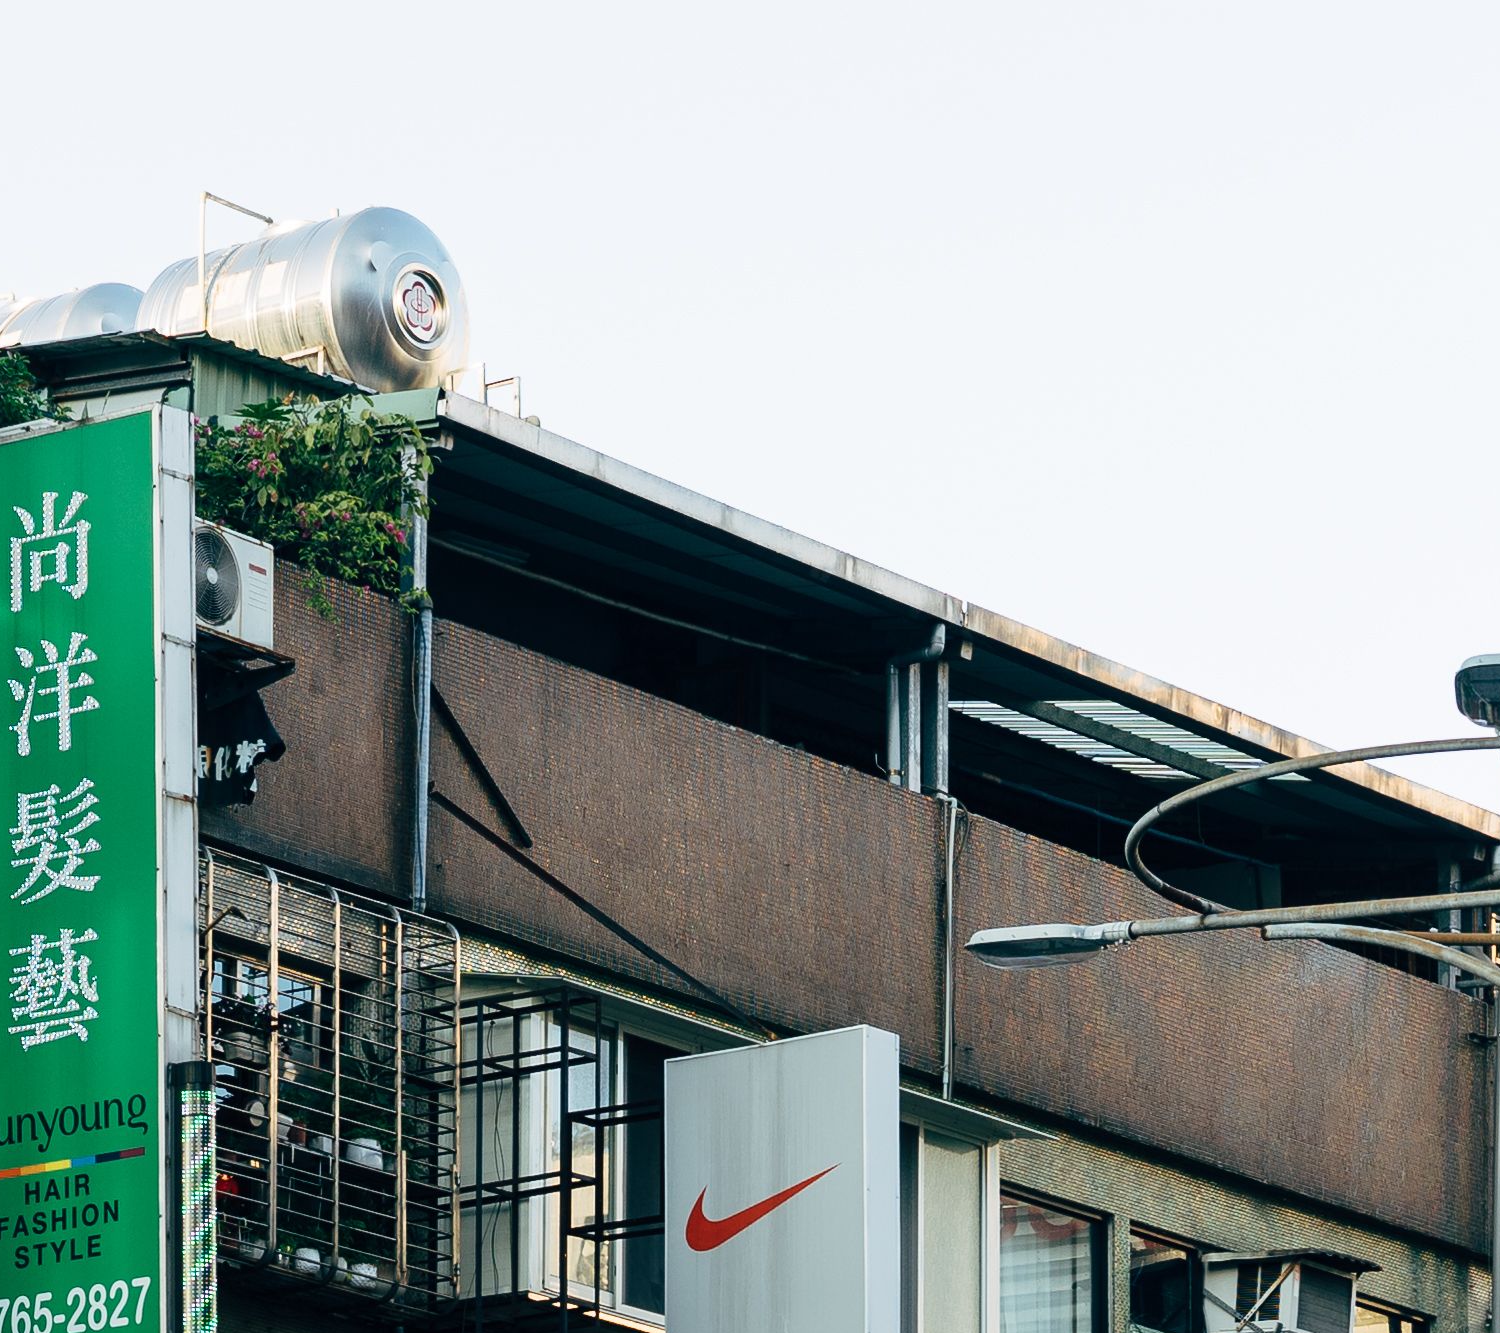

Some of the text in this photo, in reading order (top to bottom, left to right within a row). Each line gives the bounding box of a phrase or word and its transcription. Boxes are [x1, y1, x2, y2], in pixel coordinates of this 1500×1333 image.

[6, 489, 102, 1053] 尚洋髮藝
[23, 1173, 92, 1204] HAIR
[13, 1234, 103, 1270] STYLE
